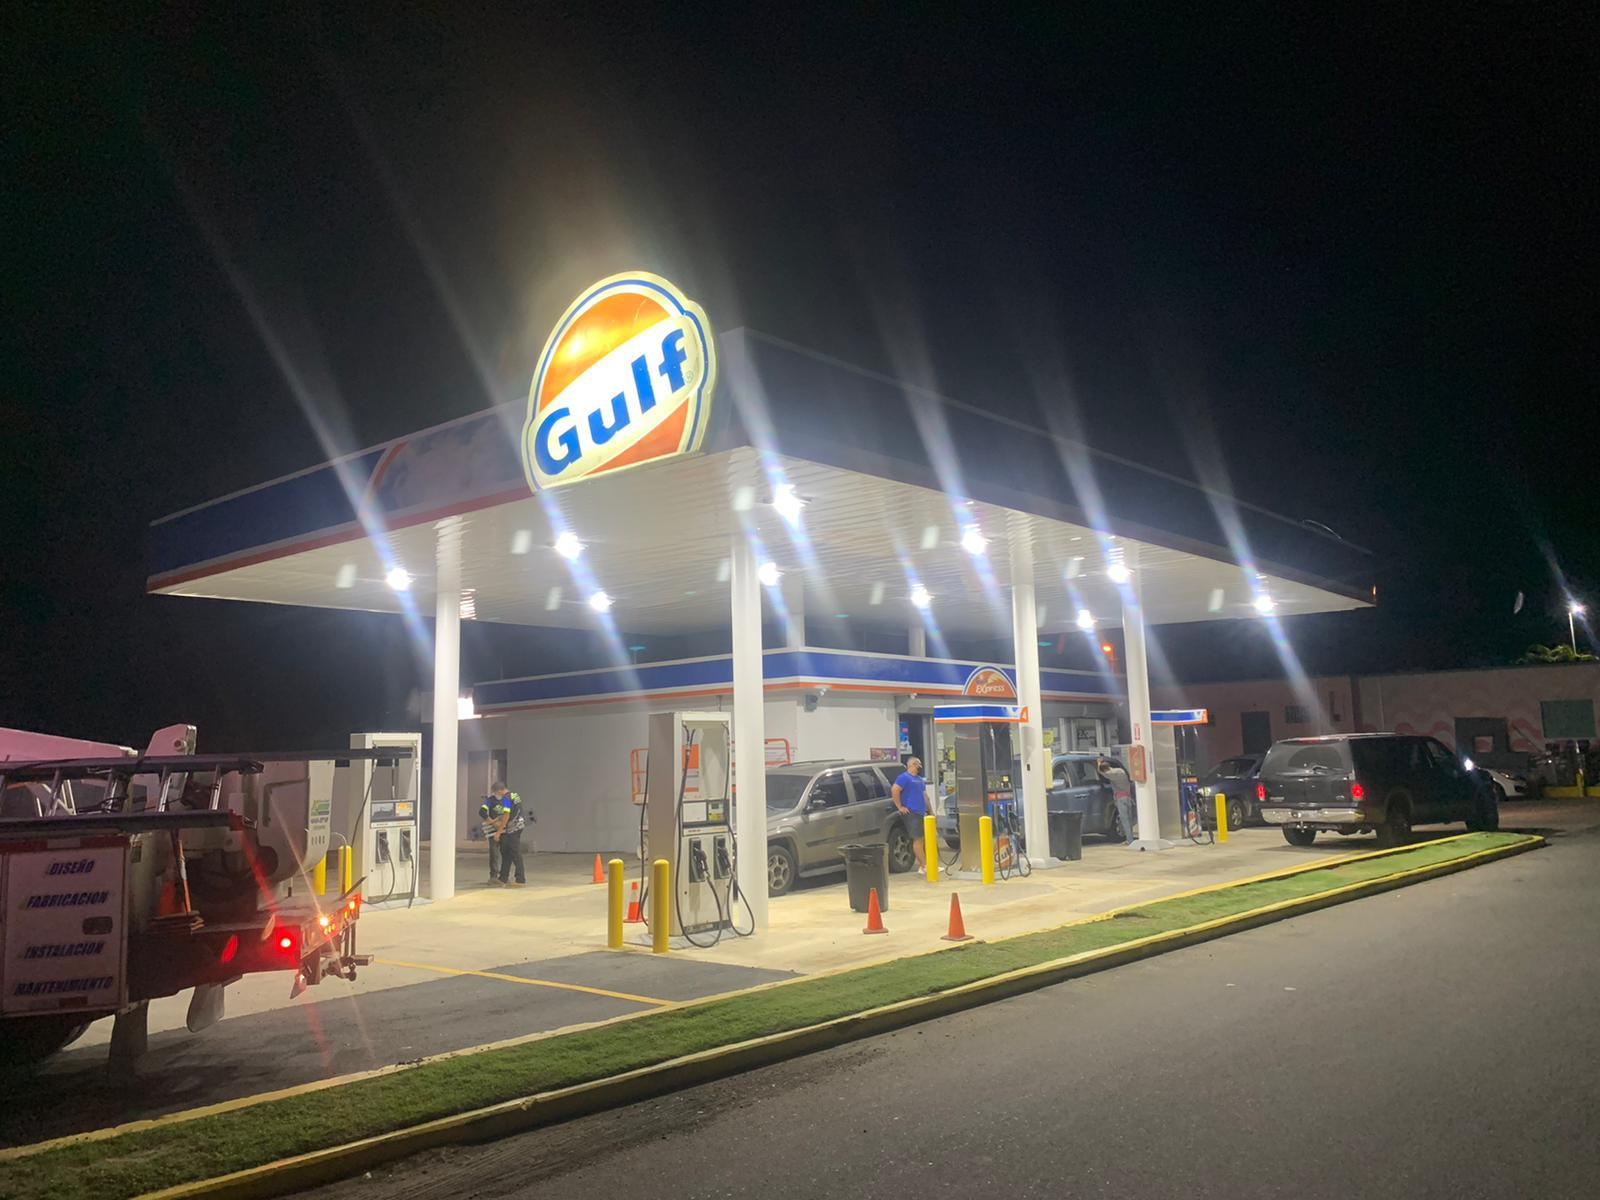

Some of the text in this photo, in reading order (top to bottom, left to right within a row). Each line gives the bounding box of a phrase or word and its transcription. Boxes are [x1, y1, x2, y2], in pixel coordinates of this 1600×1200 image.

[535, 328, 687, 476] Gulf
[48, 859, 96, 876] DISEÑO
[27, 891, 110, 909] FABRICACION
[24, 942, 105, 960] INSTALACION
[14, 976, 114, 997] MANTENIMIENTO
